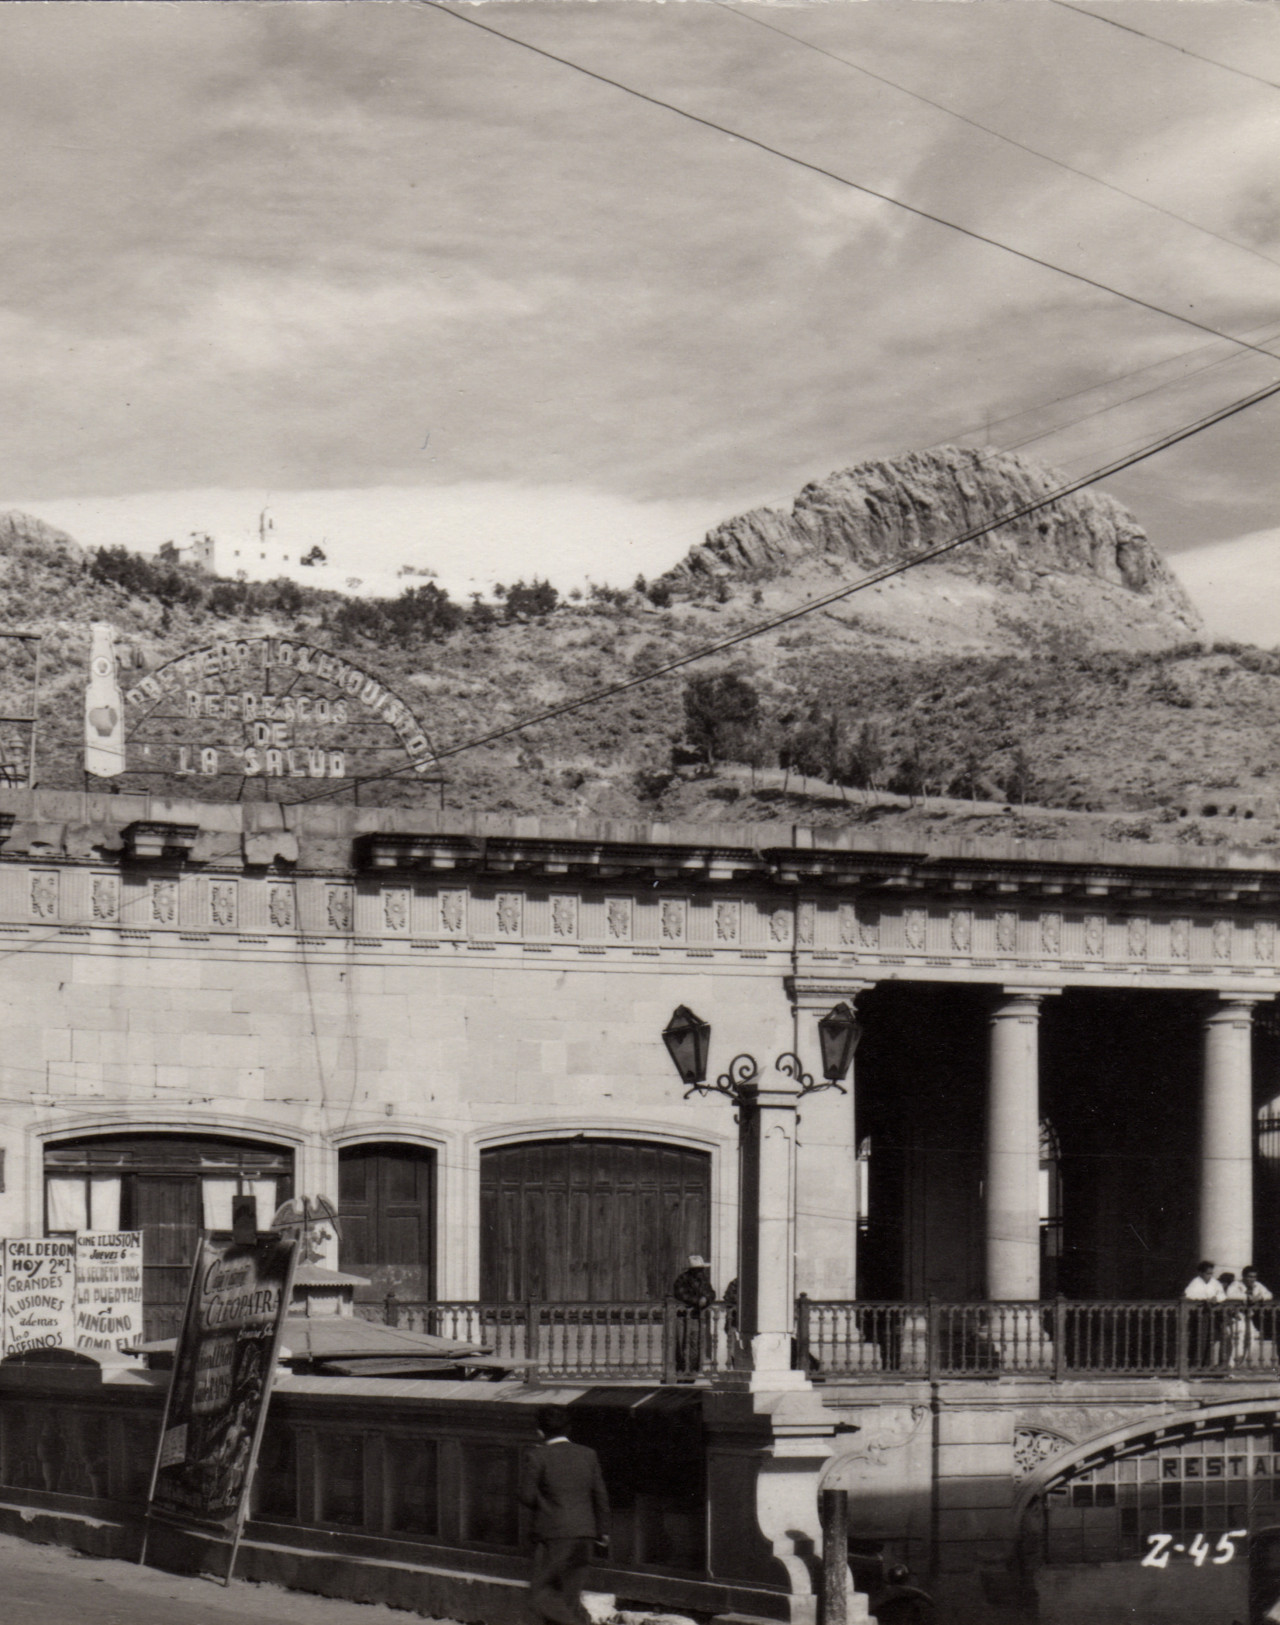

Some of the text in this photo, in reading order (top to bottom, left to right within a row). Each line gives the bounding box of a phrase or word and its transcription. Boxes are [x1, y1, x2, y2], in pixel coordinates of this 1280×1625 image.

[186, 690, 348, 724] REFRESCOS
[254, 722, 289, 747] DE
[178, 747, 347, 778] LA SALUD
[77, 1232, 141, 1248] CINE ILUSION
[8, 1242, 74, 1257] CALDERON
[120, 1248, 127, 1260] 6
[12, 1259, 44, 1278] HOY
[87, 1266, 119, 1283] SECRETO
[7, 1275, 63, 1293] GRANDES
[77, 1288, 90, 1304] LA
[7, 1295, 64, 1318] ILUSIONES
[77, 1311, 132, 1333] NINGUNO
